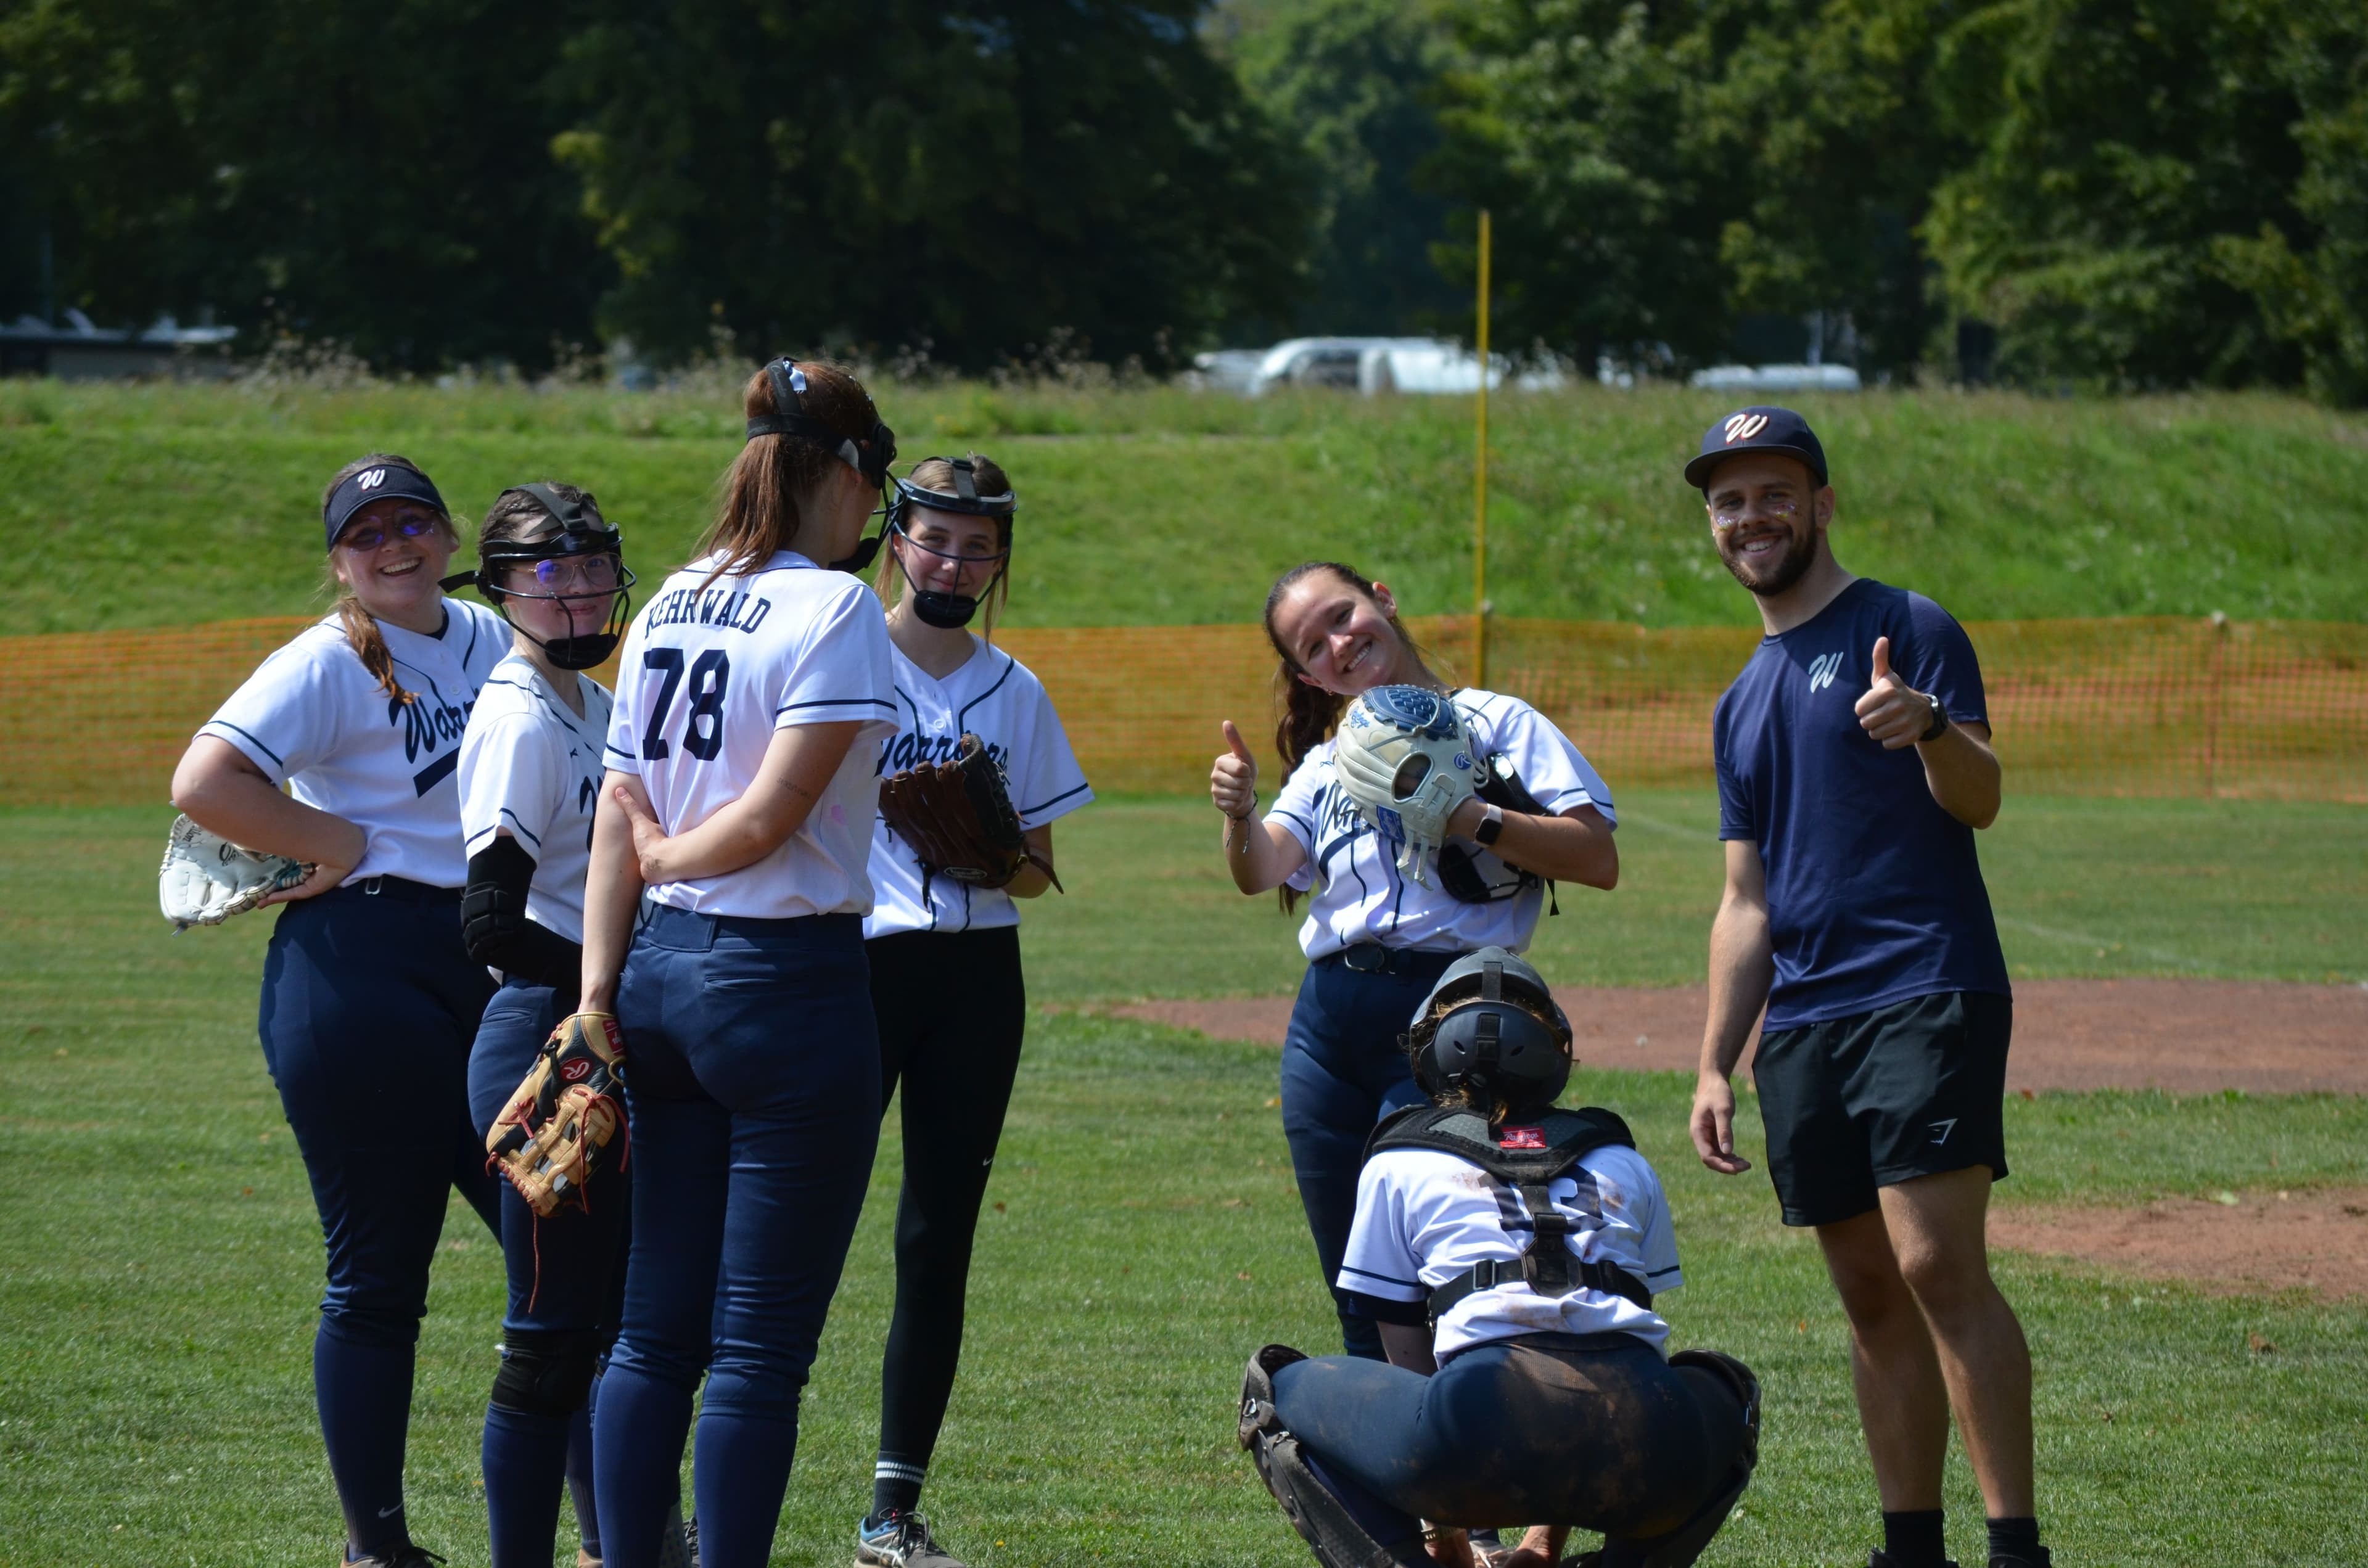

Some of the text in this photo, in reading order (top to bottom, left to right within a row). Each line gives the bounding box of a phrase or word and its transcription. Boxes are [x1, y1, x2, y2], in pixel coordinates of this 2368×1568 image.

[1725, 414, 1769, 445] W
[357, 469, 386, 491] W
[644, 588, 771, 639] KEHRWALD
[1808, 651, 1844, 694] W
[642, 647, 730, 761] 78
